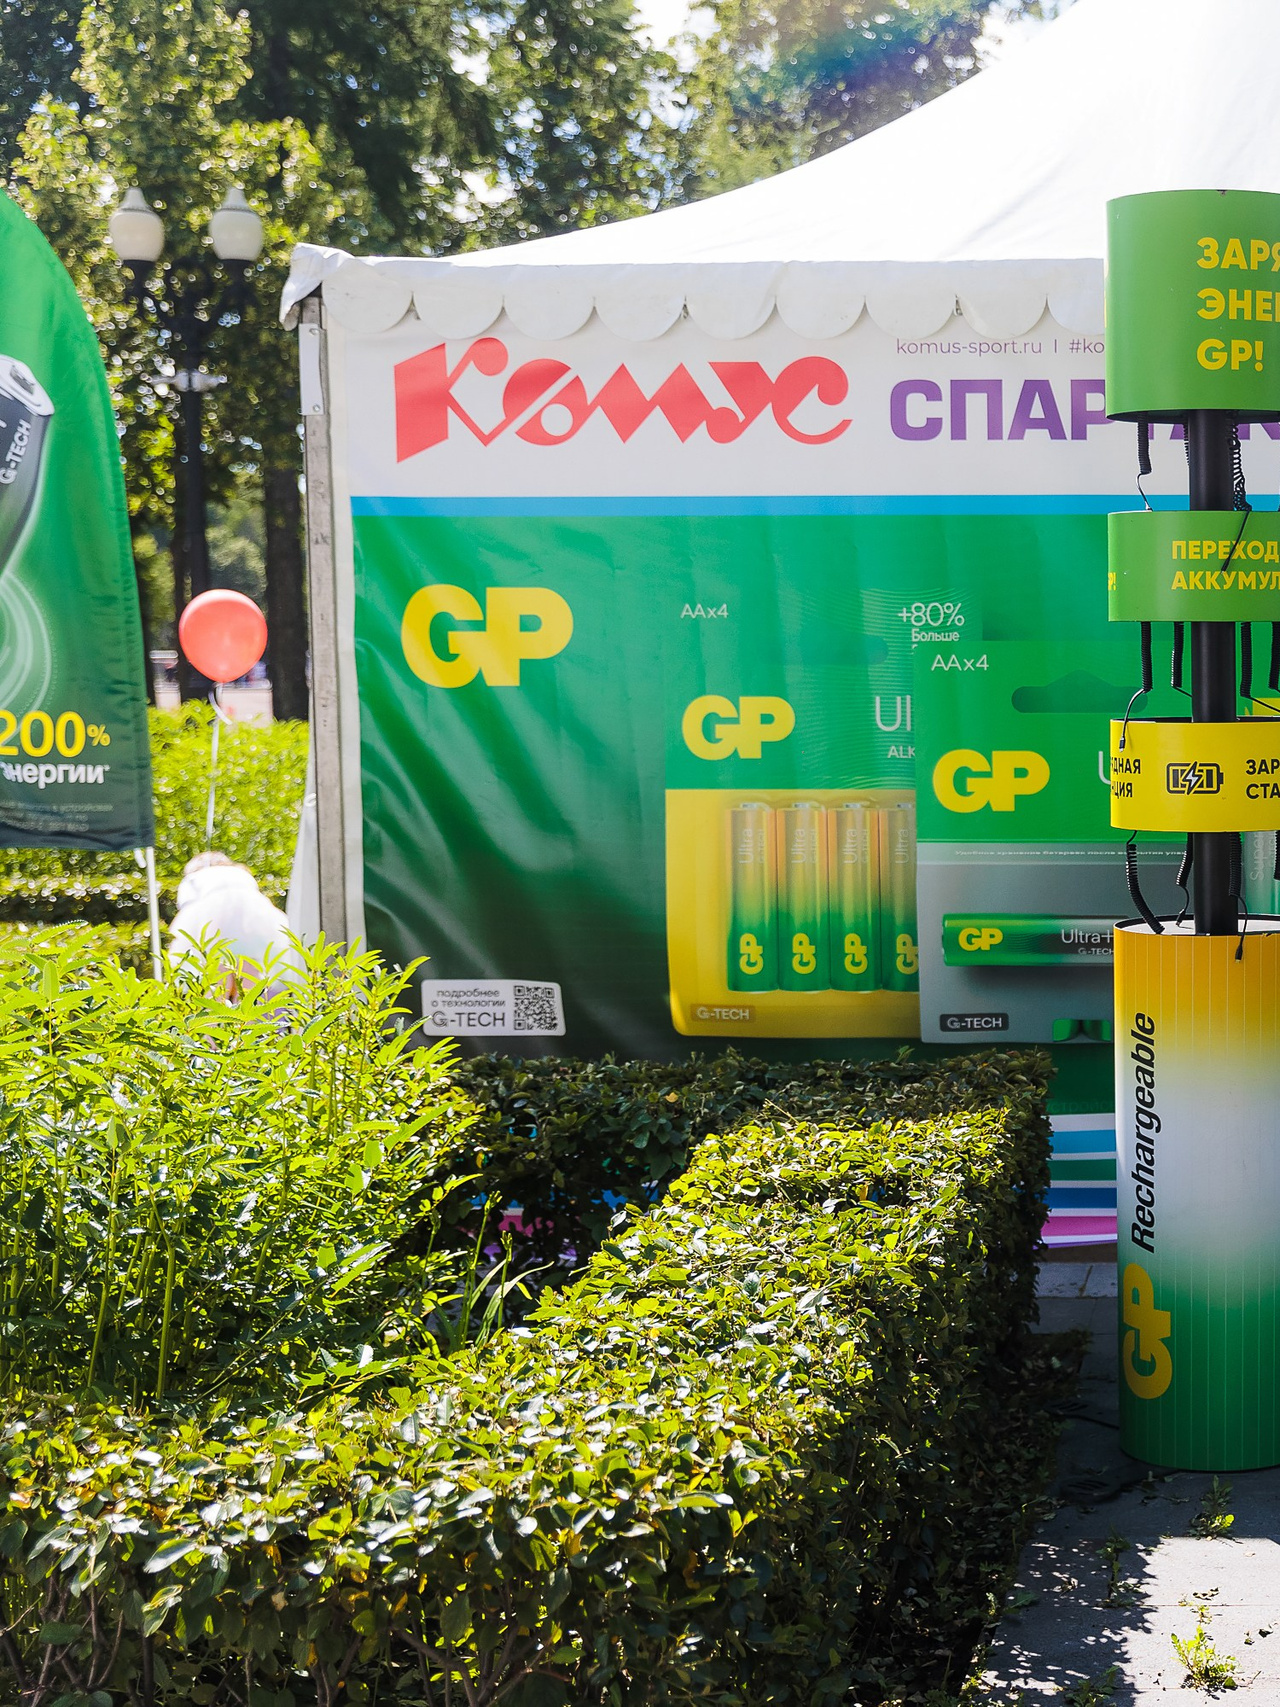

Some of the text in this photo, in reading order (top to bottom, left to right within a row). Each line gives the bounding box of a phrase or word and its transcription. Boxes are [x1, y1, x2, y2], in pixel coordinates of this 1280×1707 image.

[896, 338, 1042, 357] komus-sport.ru
[1196, 338, 1263, 372] GP!
[898, 602, 965, 626] +80%
[401, 584, 574, 689] GP
[911, 628, 960, 643] Больше
[682, 695, 796, 760] GP
[933, 749, 1050, 813] GP
[958, 927, 1004, 951] GP
[1061, 929, 1114, 944] Ultra+
[739, 933, 764, 975] GP
[792, 933, 816, 975] GP
[844, 933, 868, 975] GP
[896, 934, 919, 975] GP
[436, 988, 500, 999] подробнее
[442, 1000, 506, 1008] технологии
[431, 1011, 505, 1028] G-TECH
[697, 1006, 749, 1021] G-TECH
[947, 1017, 1002, 1030] G-TECH
[1131, 1012, 1161, 1253] Rechargeable
[1122, 1263, 1173, 1400] GP
